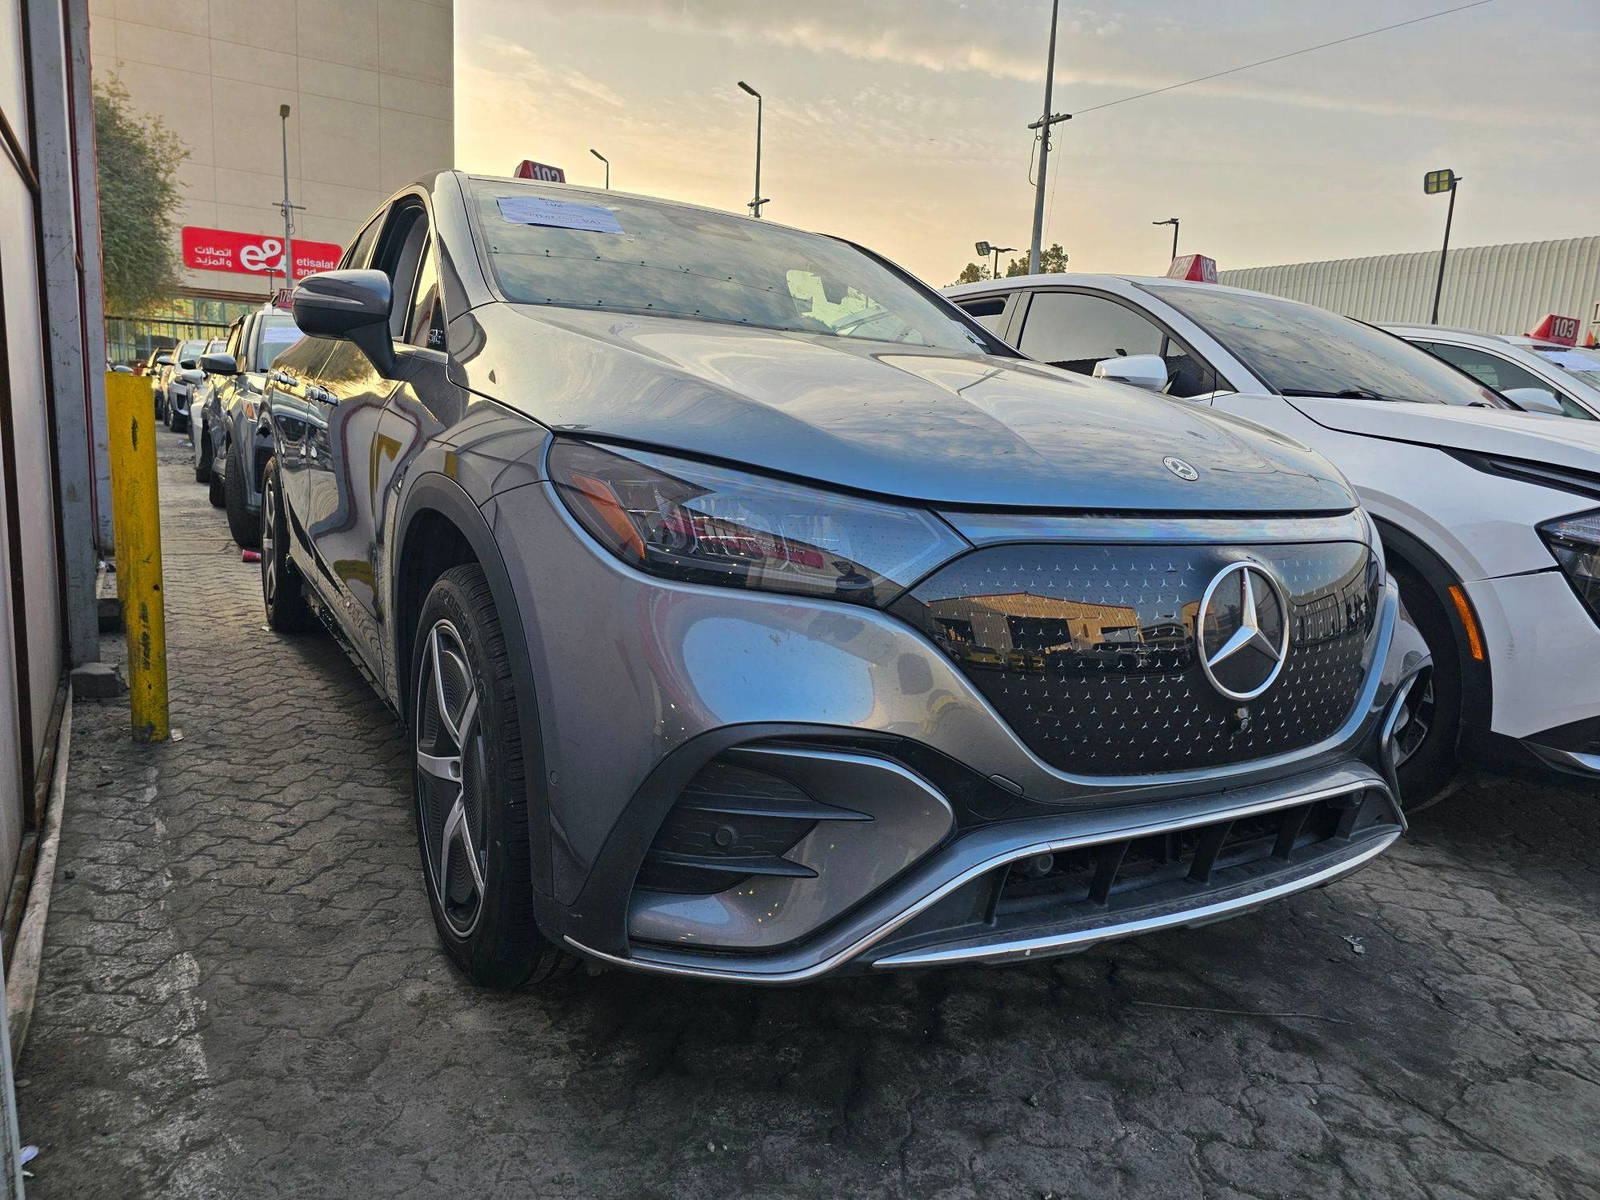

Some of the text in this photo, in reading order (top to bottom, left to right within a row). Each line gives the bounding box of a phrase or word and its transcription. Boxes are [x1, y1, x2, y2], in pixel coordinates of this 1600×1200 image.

[194, 246, 232, 257] اتصالات
[296, 258, 334, 269] etisalat
[1554, 318, 1576, 338] 103
